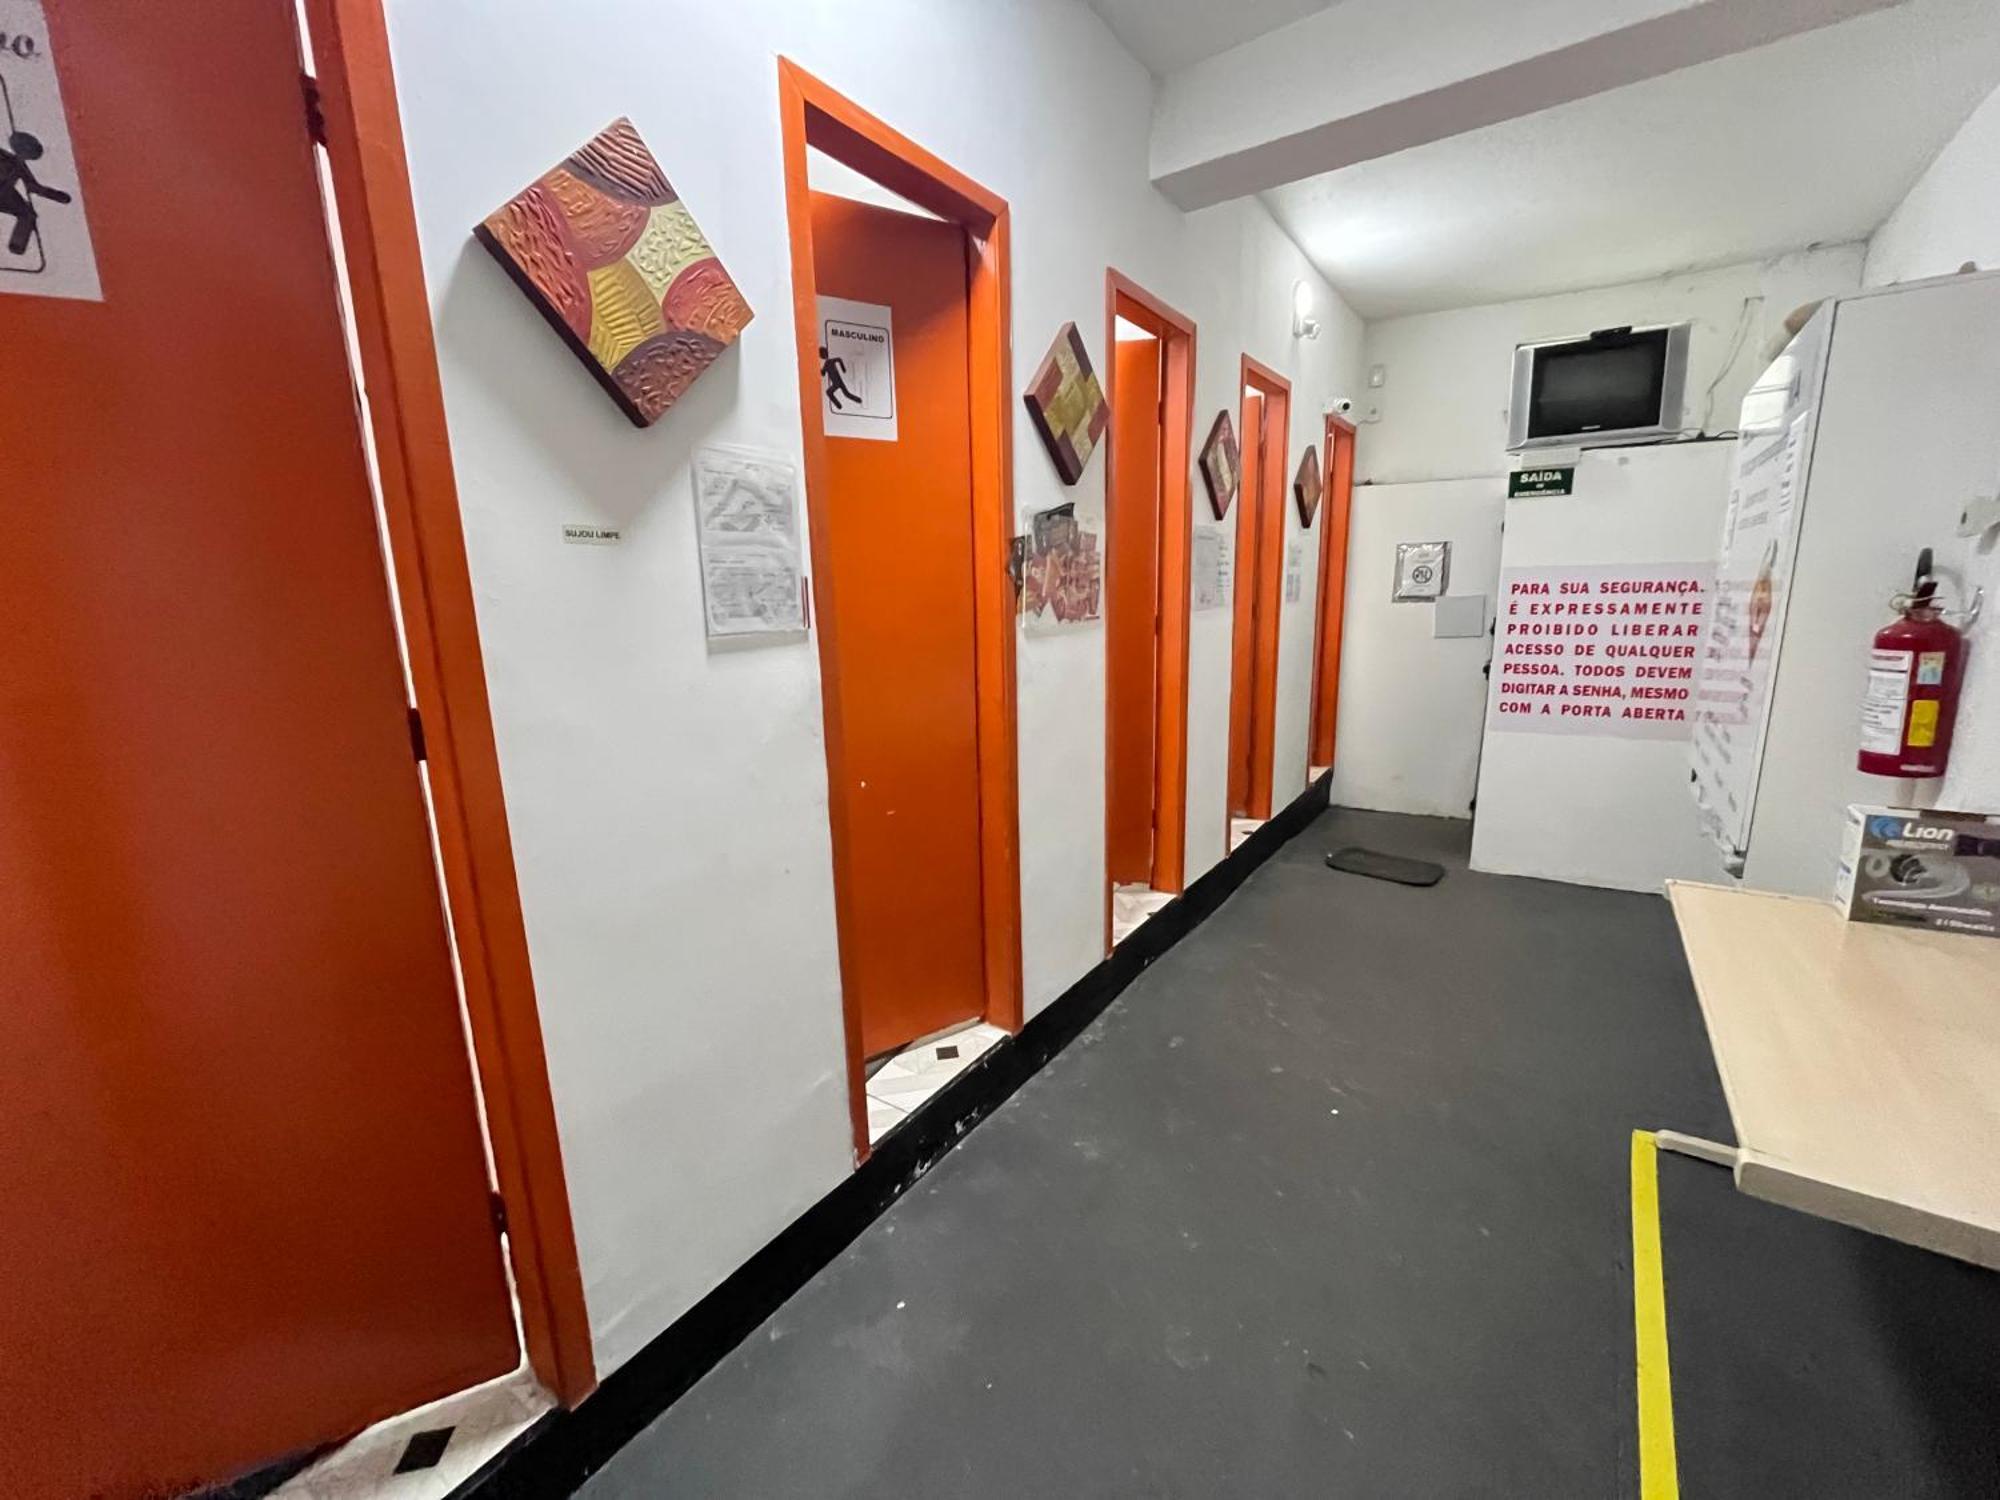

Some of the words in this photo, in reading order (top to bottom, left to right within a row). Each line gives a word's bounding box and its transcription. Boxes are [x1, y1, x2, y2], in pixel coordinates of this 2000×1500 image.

[831, 328, 885, 343] MASCULINO
[1519, 471, 1562, 483] SAÍDA
[565, 530, 594, 538] SUJOU
[1511, 583, 1550, 595] PARA
[1559, 582, 1590, 594] SUA
[1509, 601, 1518, 615] É
[1530, 602, 1703, 615] EXPRESSAMENTE
[1507, 623, 1598, 636] PROIBIDO
[1611, 624, 1699, 636] LIBERAR
[1505, 644, 1564, 655] ACESSO
[1574, 644, 1595, 656] DE
[1605, 645, 1695, 658] QUALQUER
[1503, 663, 1565, 676] PESSOA.
[1575, 665, 1625, 677] TODOS
[1635, 666, 1692, 679] DEVEM
[1501, 683, 1556, 695] DIGITAR
[1559, 684, 1569, 695] A
[1573, 685, 1626, 699] SENHA,
[1630, 687, 1689, 700] MESMO
[1499, 702, 1531, 713] COM
[1541, 704, 1551, 715] A
[1561, 705, 1611, 717] PORTA
[1622, 707, 1685, 720] ABERTA
[1902, 822, 1954, 841] Lion
